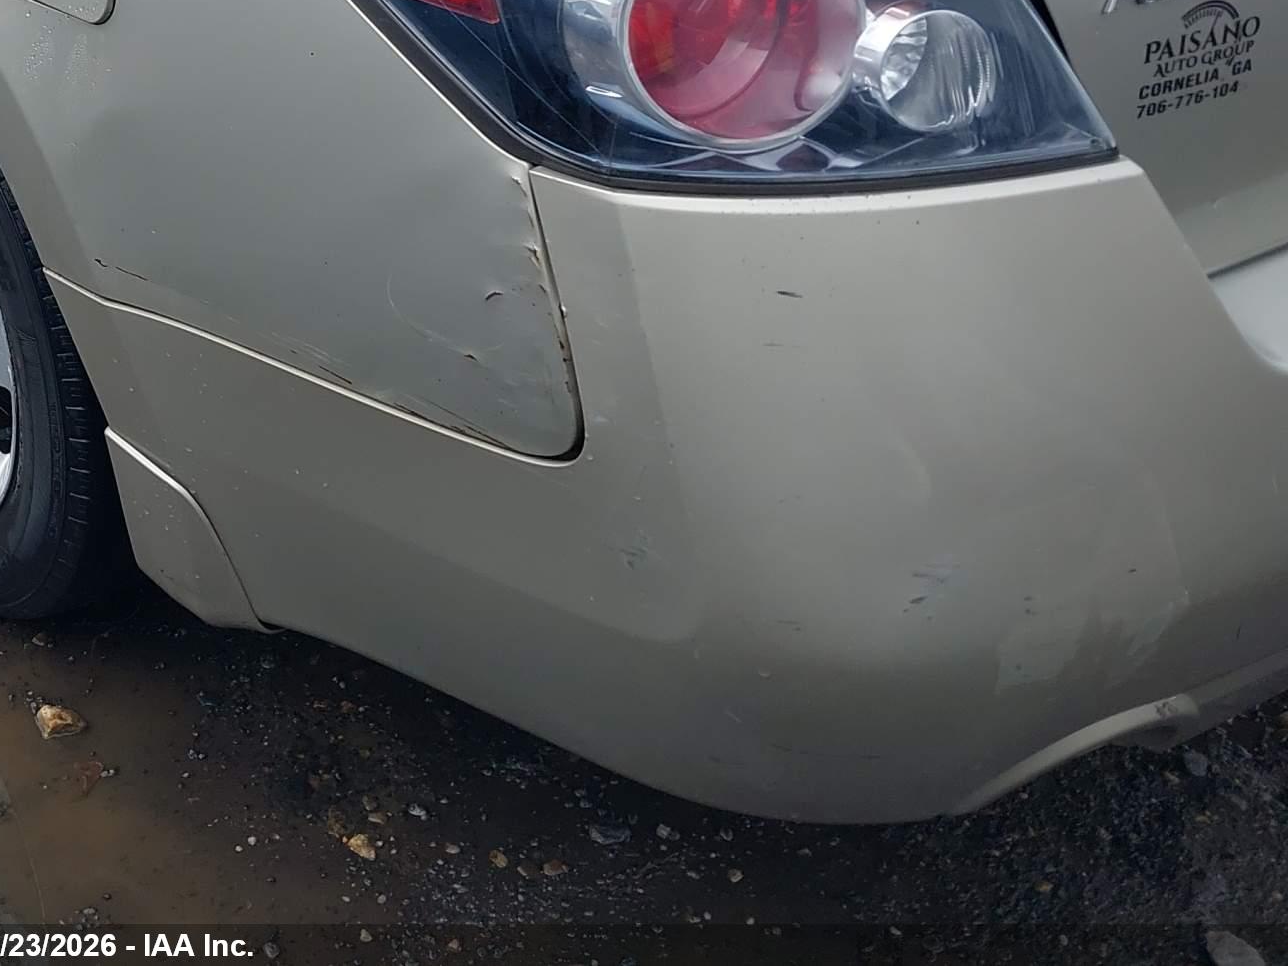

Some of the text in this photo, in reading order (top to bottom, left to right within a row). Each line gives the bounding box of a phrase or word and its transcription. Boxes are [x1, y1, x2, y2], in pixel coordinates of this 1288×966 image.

[1143, 16, 1260, 64] PAISANO
[1153, 40, 1254, 78] AUTO GROUP
[1138, 59, 1252, 100] CORNELIA GA
